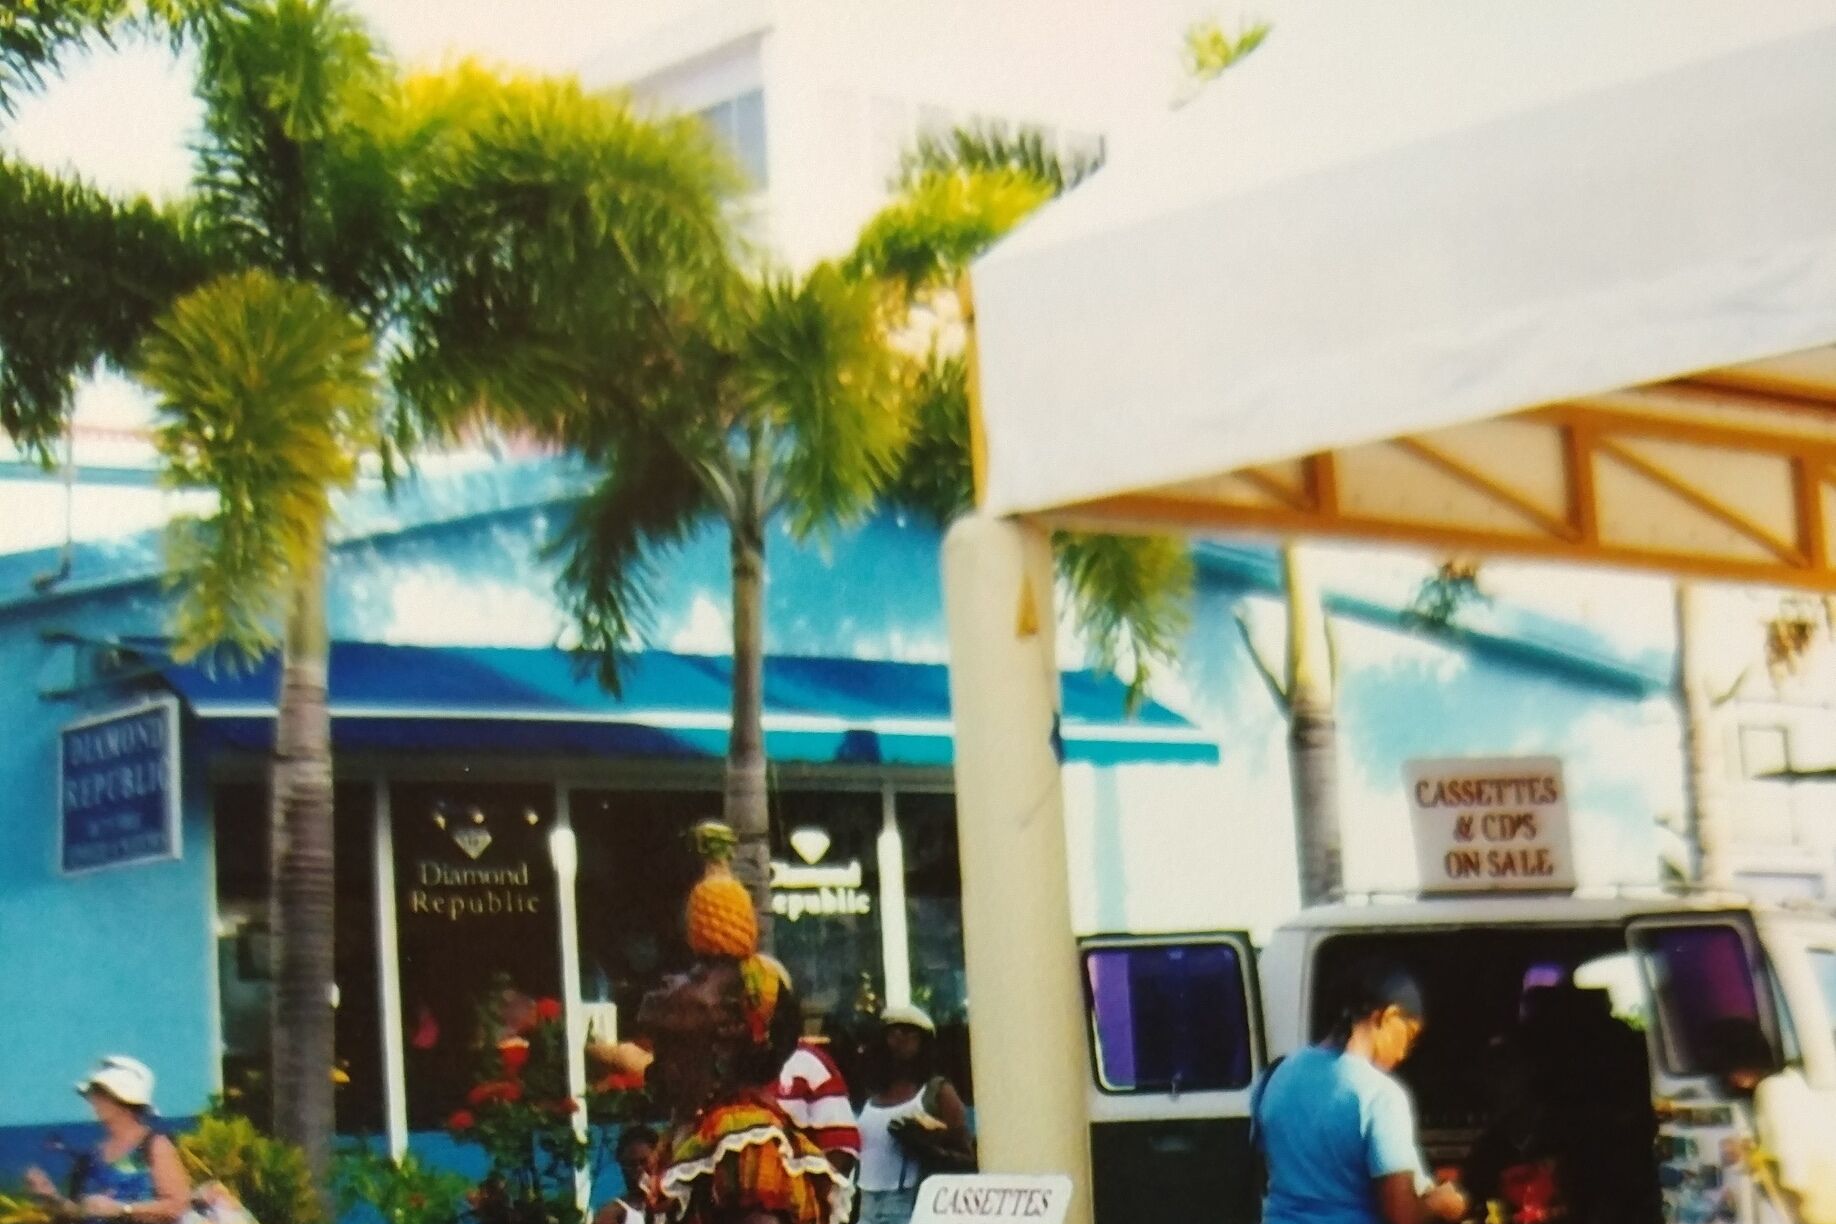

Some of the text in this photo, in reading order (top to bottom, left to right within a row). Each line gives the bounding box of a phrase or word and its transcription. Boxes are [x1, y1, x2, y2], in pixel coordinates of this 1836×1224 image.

[1414, 776, 1558, 809] CASSETTES
[1452, 814, 1475, 843] &
[420, 862, 529, 886] Diamond
[1443, 848, 1554, 879] ON SALE
[410, 889, 540, 921] Republic
[771, 888, 871, 922] epublic
[932, 1185, 1053, 1217] CASSETTES
